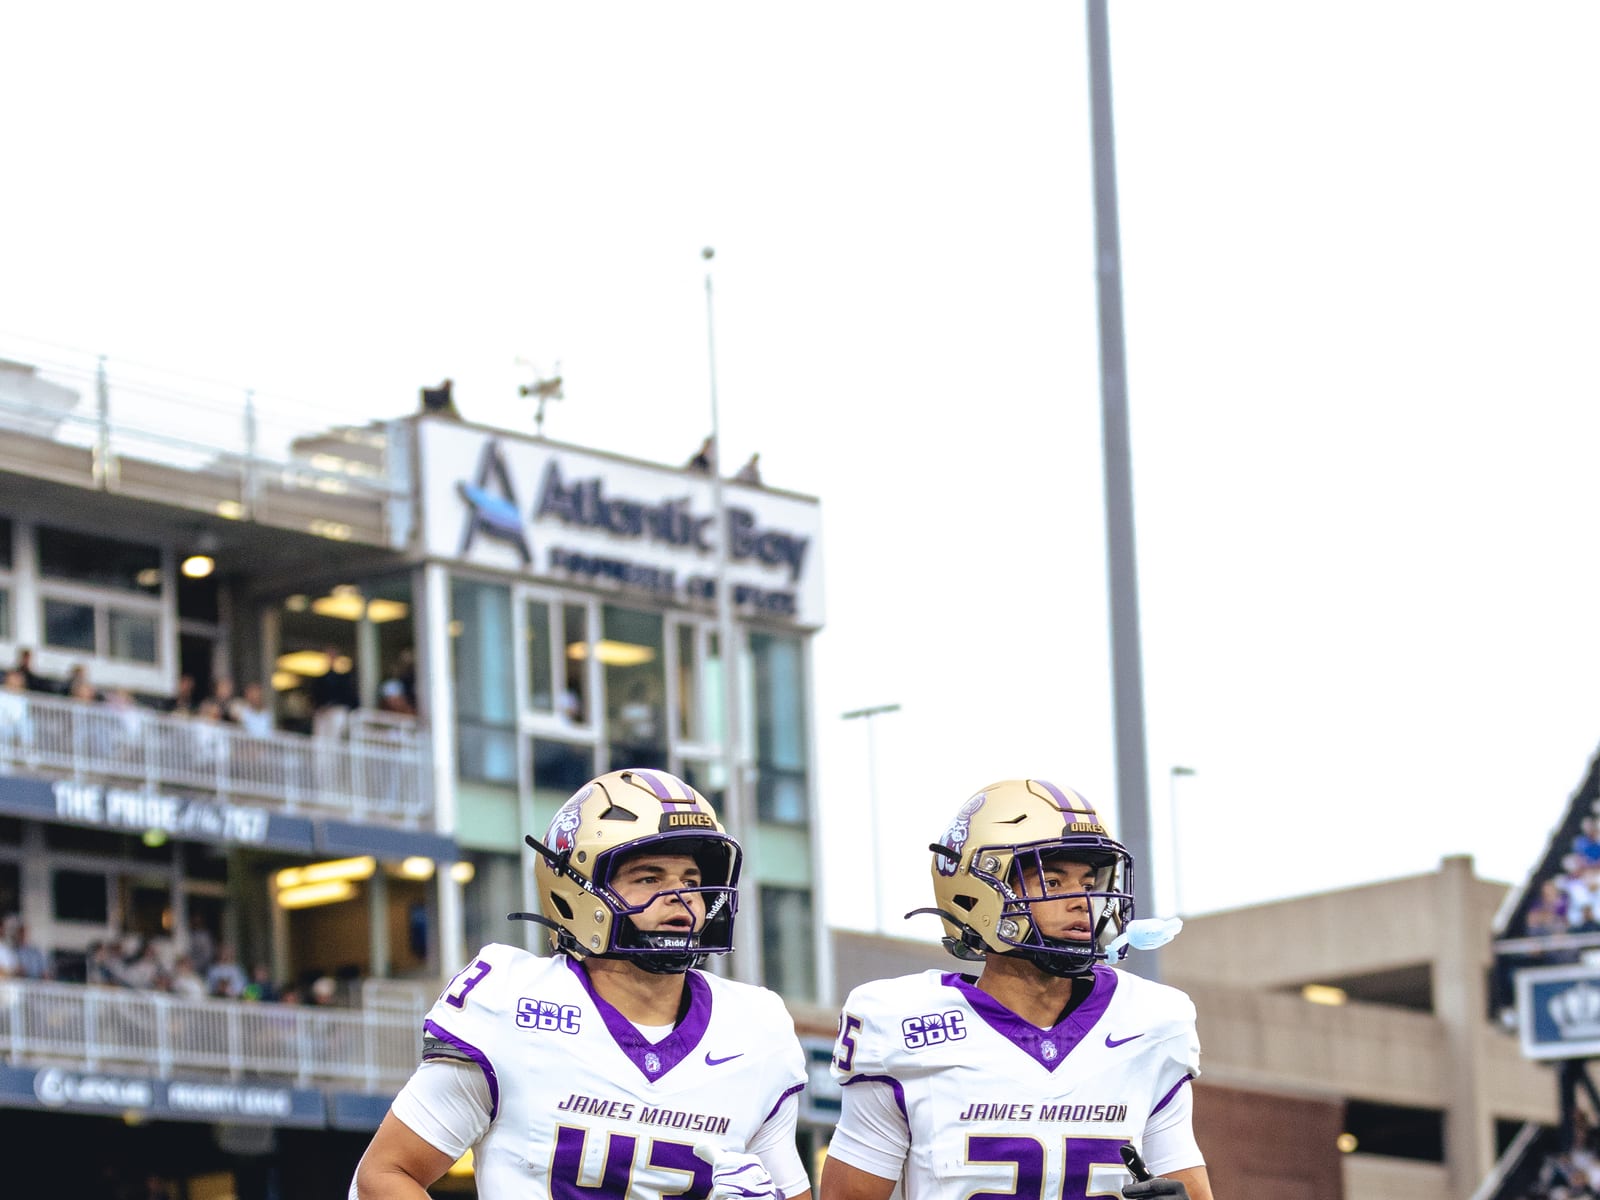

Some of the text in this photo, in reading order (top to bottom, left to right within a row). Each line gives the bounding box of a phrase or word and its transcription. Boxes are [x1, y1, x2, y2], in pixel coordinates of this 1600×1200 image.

[534, 458, 715, 553] Atlantic
[726, 506, 811, 582] Bay
[53, 780, 101, 821] THE
[669, 814, 712, 828] DUKES
[1071, 822, 1104, 834] DUKES
[664, 938, 693, 948] Riddel
[439, 959, 492, 1010] 3
[515, 997, 582, 1035] SBC
[901, 1009, 968, 1050] SBC
[832, 1011, 864, 1075] 5
[558, 1093, 732, 1136] JAMES MADISON
[959, 1103, 1128, 1123] JAMES MADISON
